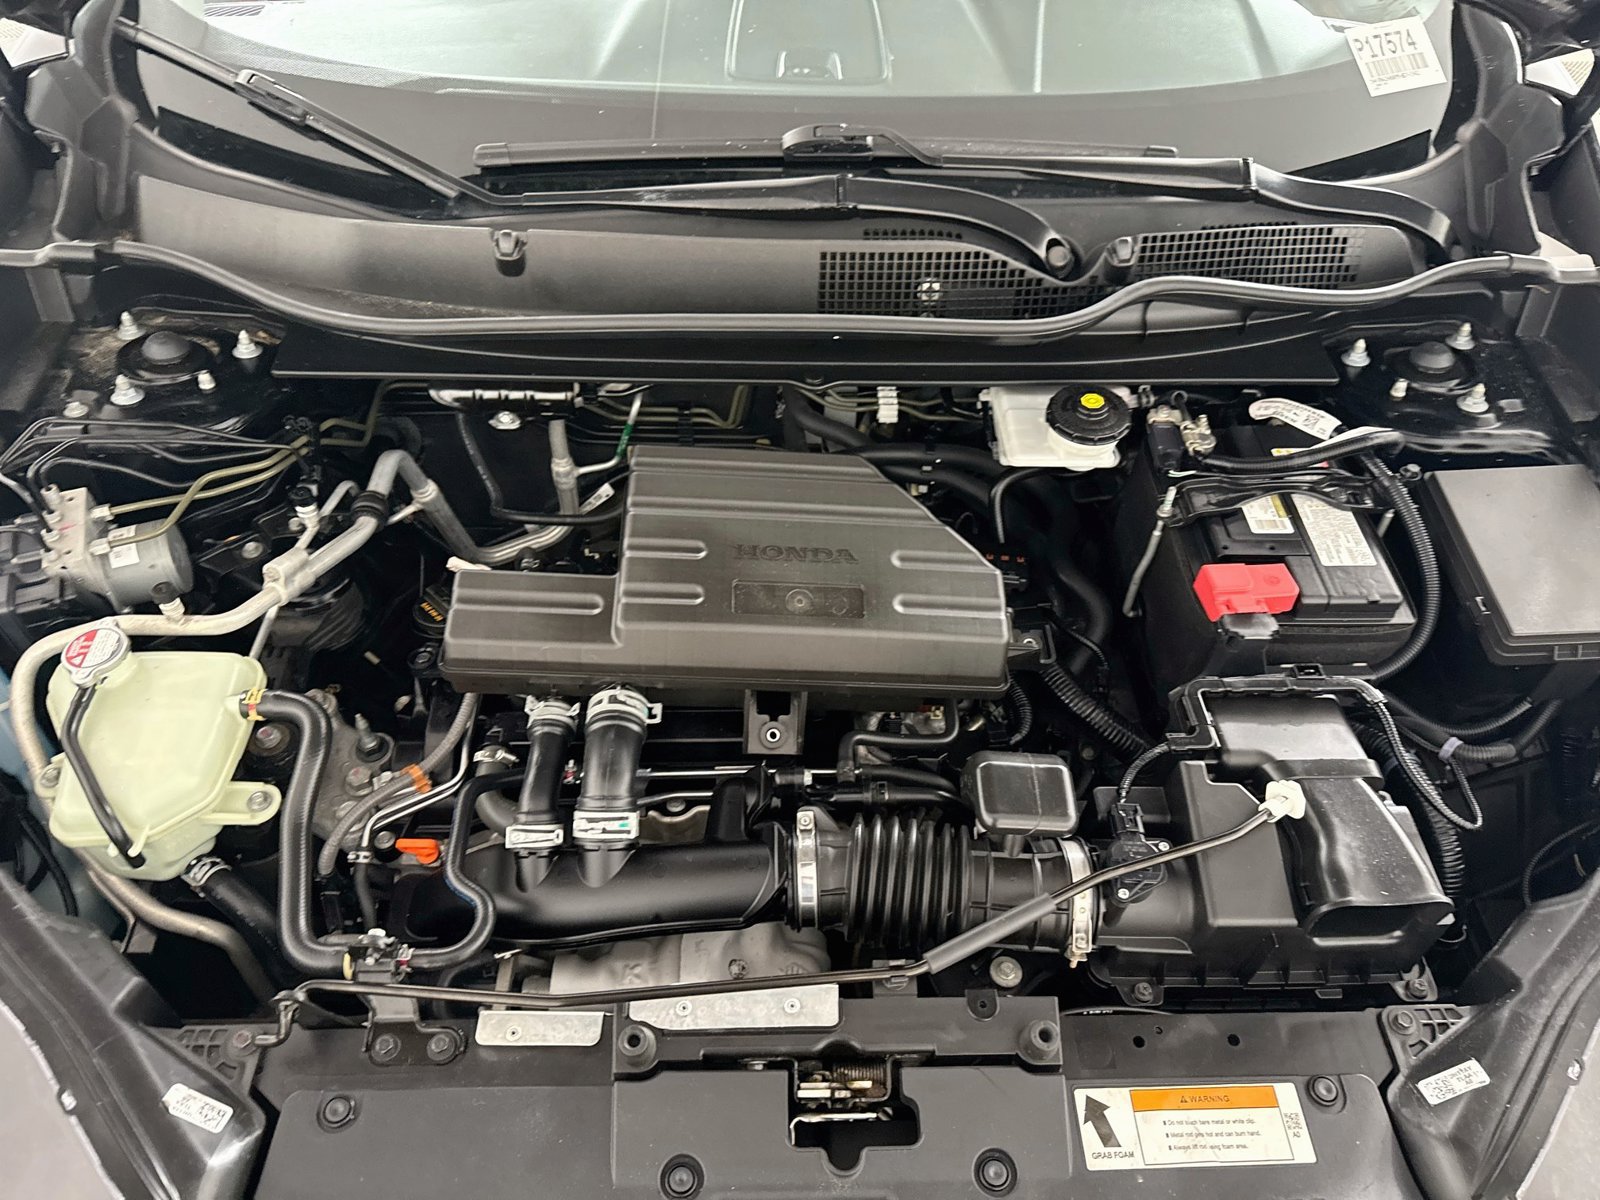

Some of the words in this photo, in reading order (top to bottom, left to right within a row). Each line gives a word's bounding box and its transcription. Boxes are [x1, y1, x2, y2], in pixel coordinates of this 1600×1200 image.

[1352, 28, 1418, 61] P17574
[731, 544, 859, 565] HONDA
[1189, 1095, 1231, 1104] WARNING
[1091, 1151, 1113, 1160] GRAB
[1114, 1151, 1135, 1159] FOAM
